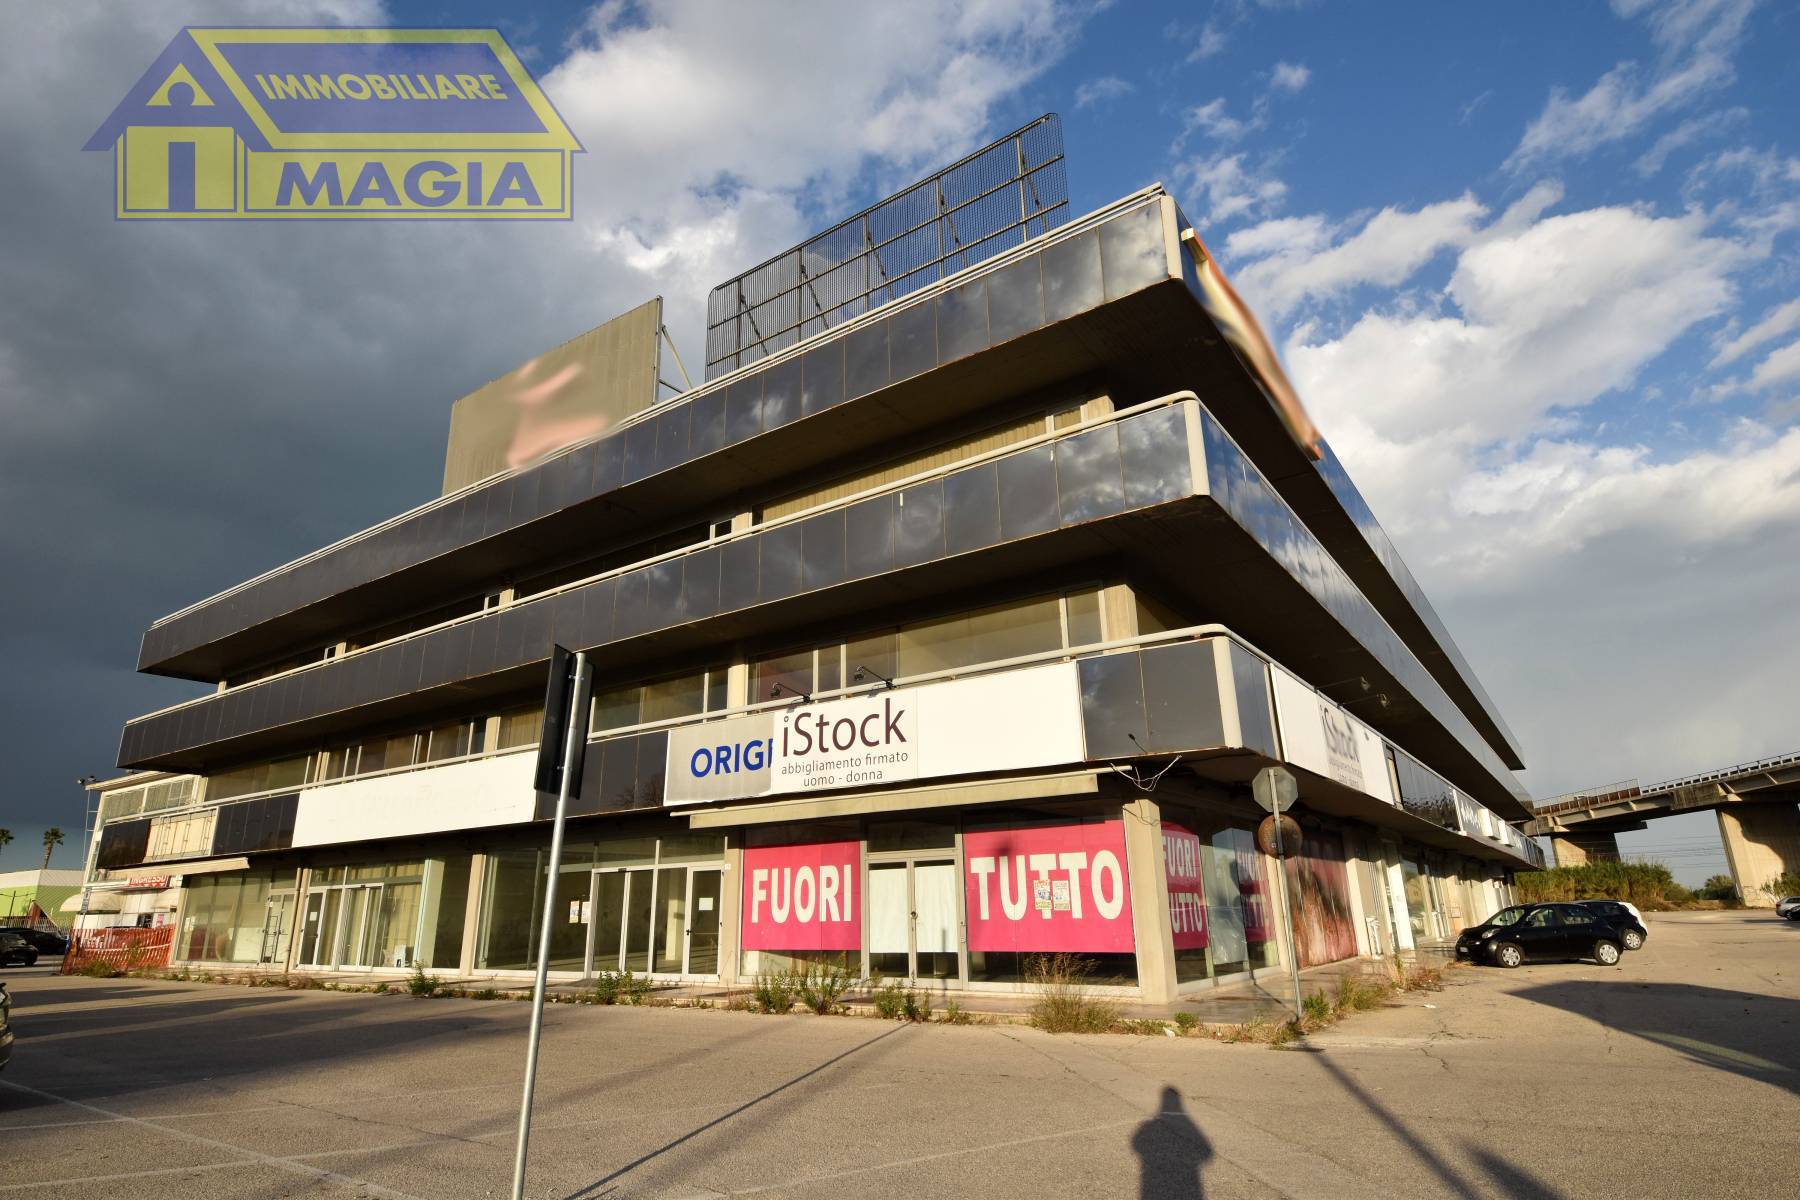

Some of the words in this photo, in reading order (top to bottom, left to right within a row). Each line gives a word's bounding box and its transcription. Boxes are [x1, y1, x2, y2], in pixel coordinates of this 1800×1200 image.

[782, 697, 908, 758] iStock
[781, 757, 862, 775] abbigliamento
[865, 751, 909, 769] firmato
[803, 774, 835, 787] uomo
[846, 769, 883, 783] donna
[751, 864, 852, 924] FUORI
[970, 849, 1123, 921] TUTTO
[1169, 892, 1203, 934] UTTO
